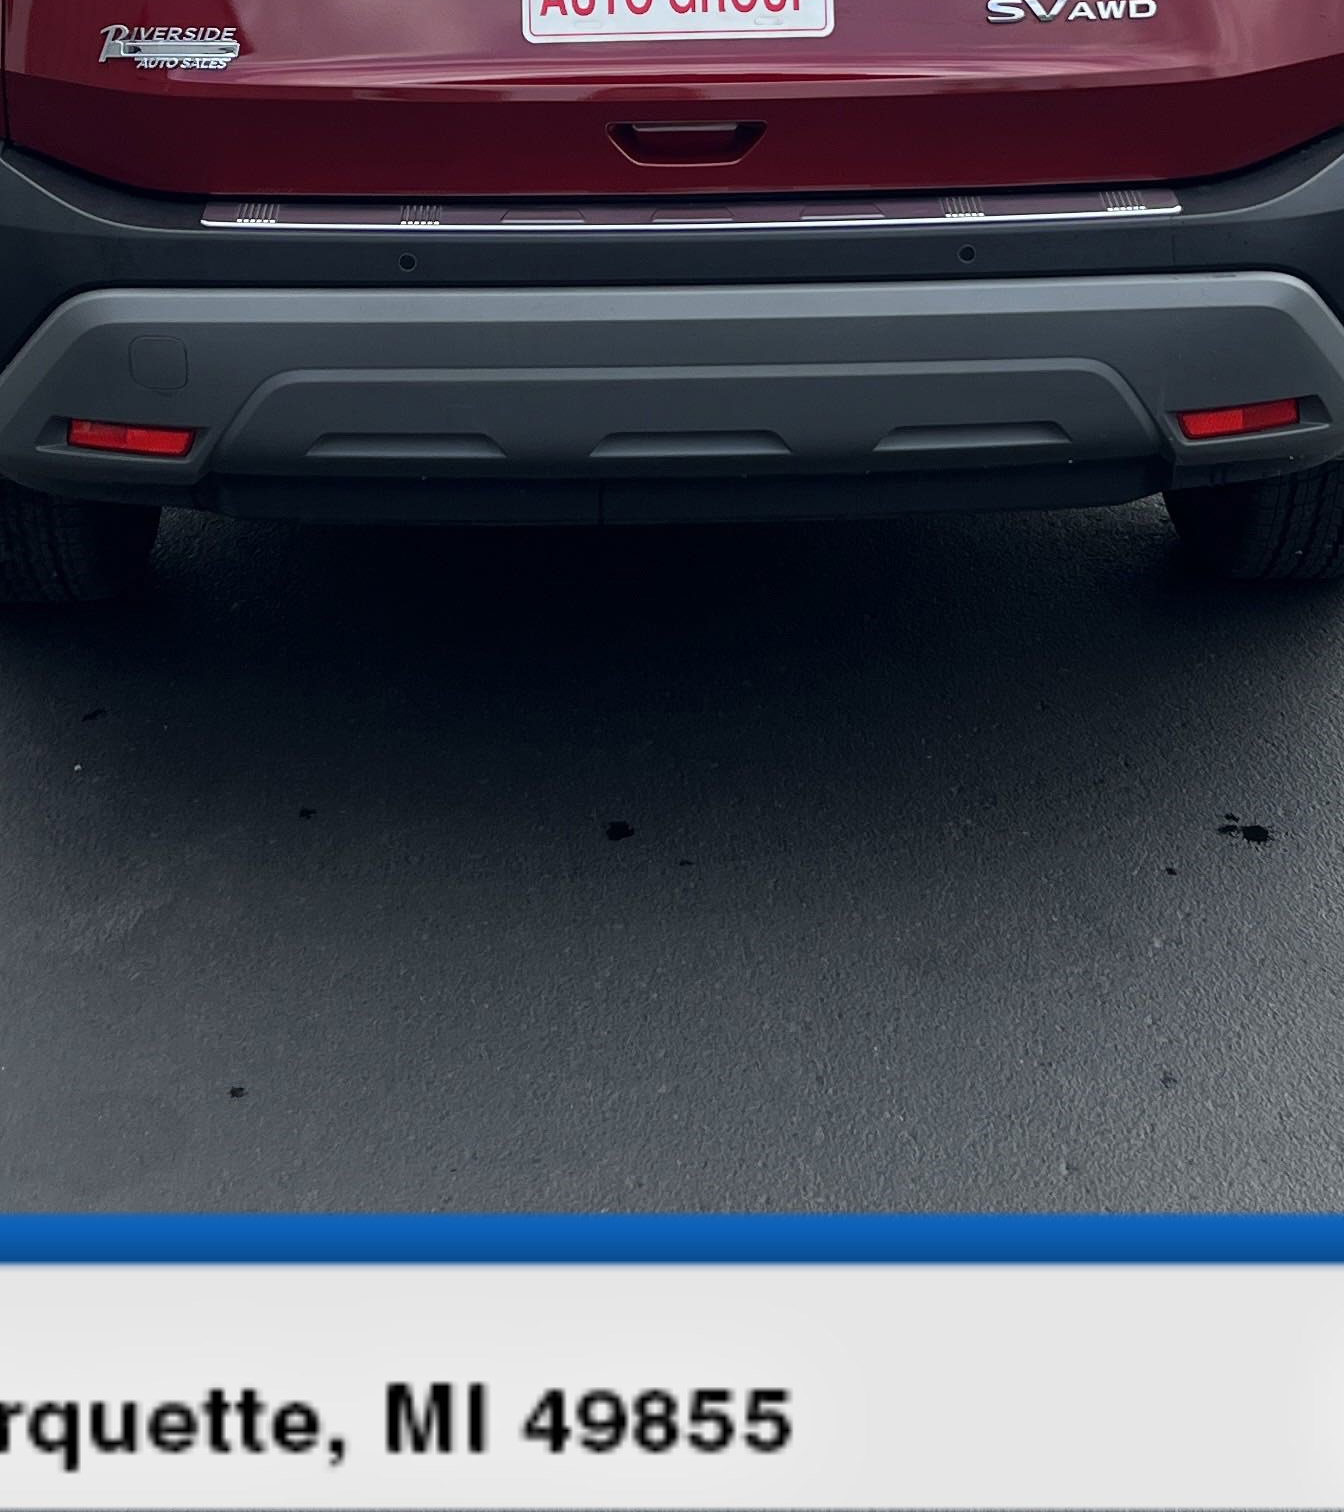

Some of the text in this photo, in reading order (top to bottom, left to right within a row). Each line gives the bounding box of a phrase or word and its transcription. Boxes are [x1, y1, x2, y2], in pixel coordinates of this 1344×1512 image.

[98, 24, 237, 62] RIVERSIDE
[135, 57, 229, 69] AUTO SALES
